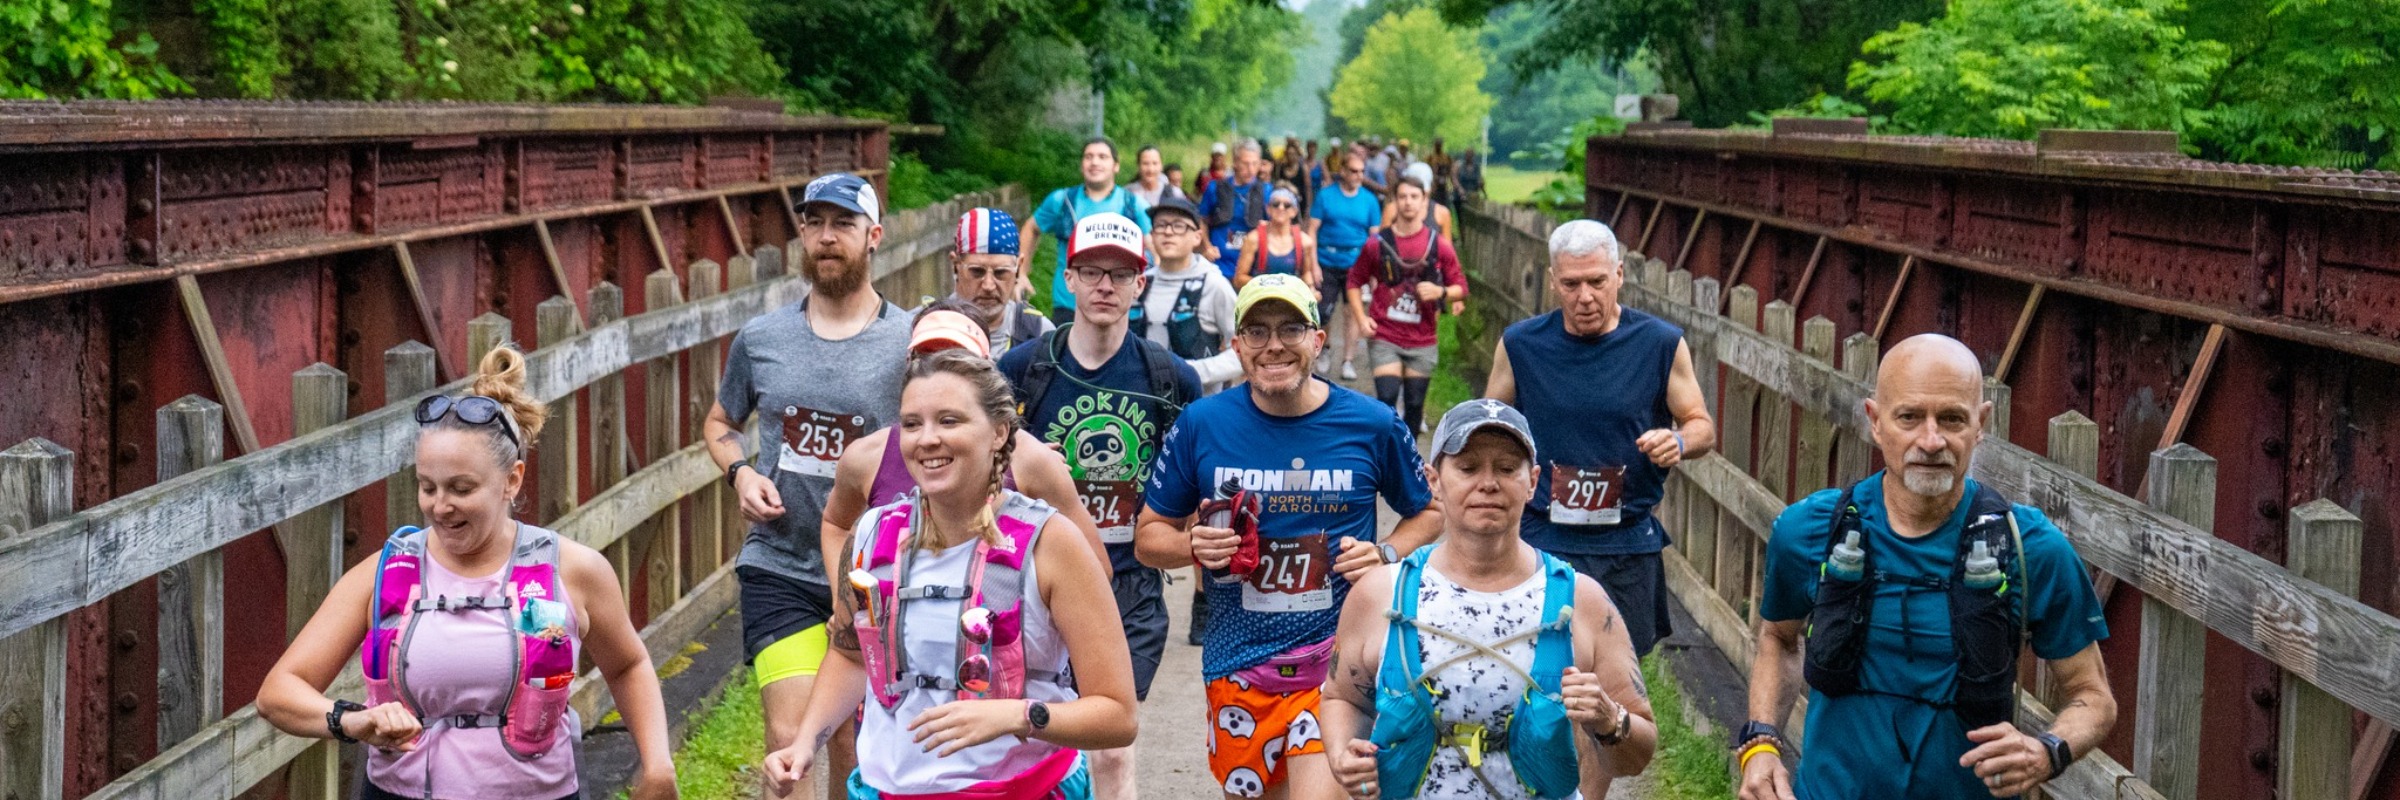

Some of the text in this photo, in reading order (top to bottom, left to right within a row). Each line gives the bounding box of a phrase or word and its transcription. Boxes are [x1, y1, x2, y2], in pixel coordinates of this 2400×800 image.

[1085, 223, 1119, 233] MELLOW
[1094, 232, 1131, 244] BREWING
[798, 422, 845, 458] 253
[1214, 465, 1353, 491] IRONMAN
[1269, 495, 1312, 504] NORTH
[1567, 480, 1609, 508] 297
[1268, 504, 1349, 513] CAROLINA
[1260, 553, 1311, 589] 247
